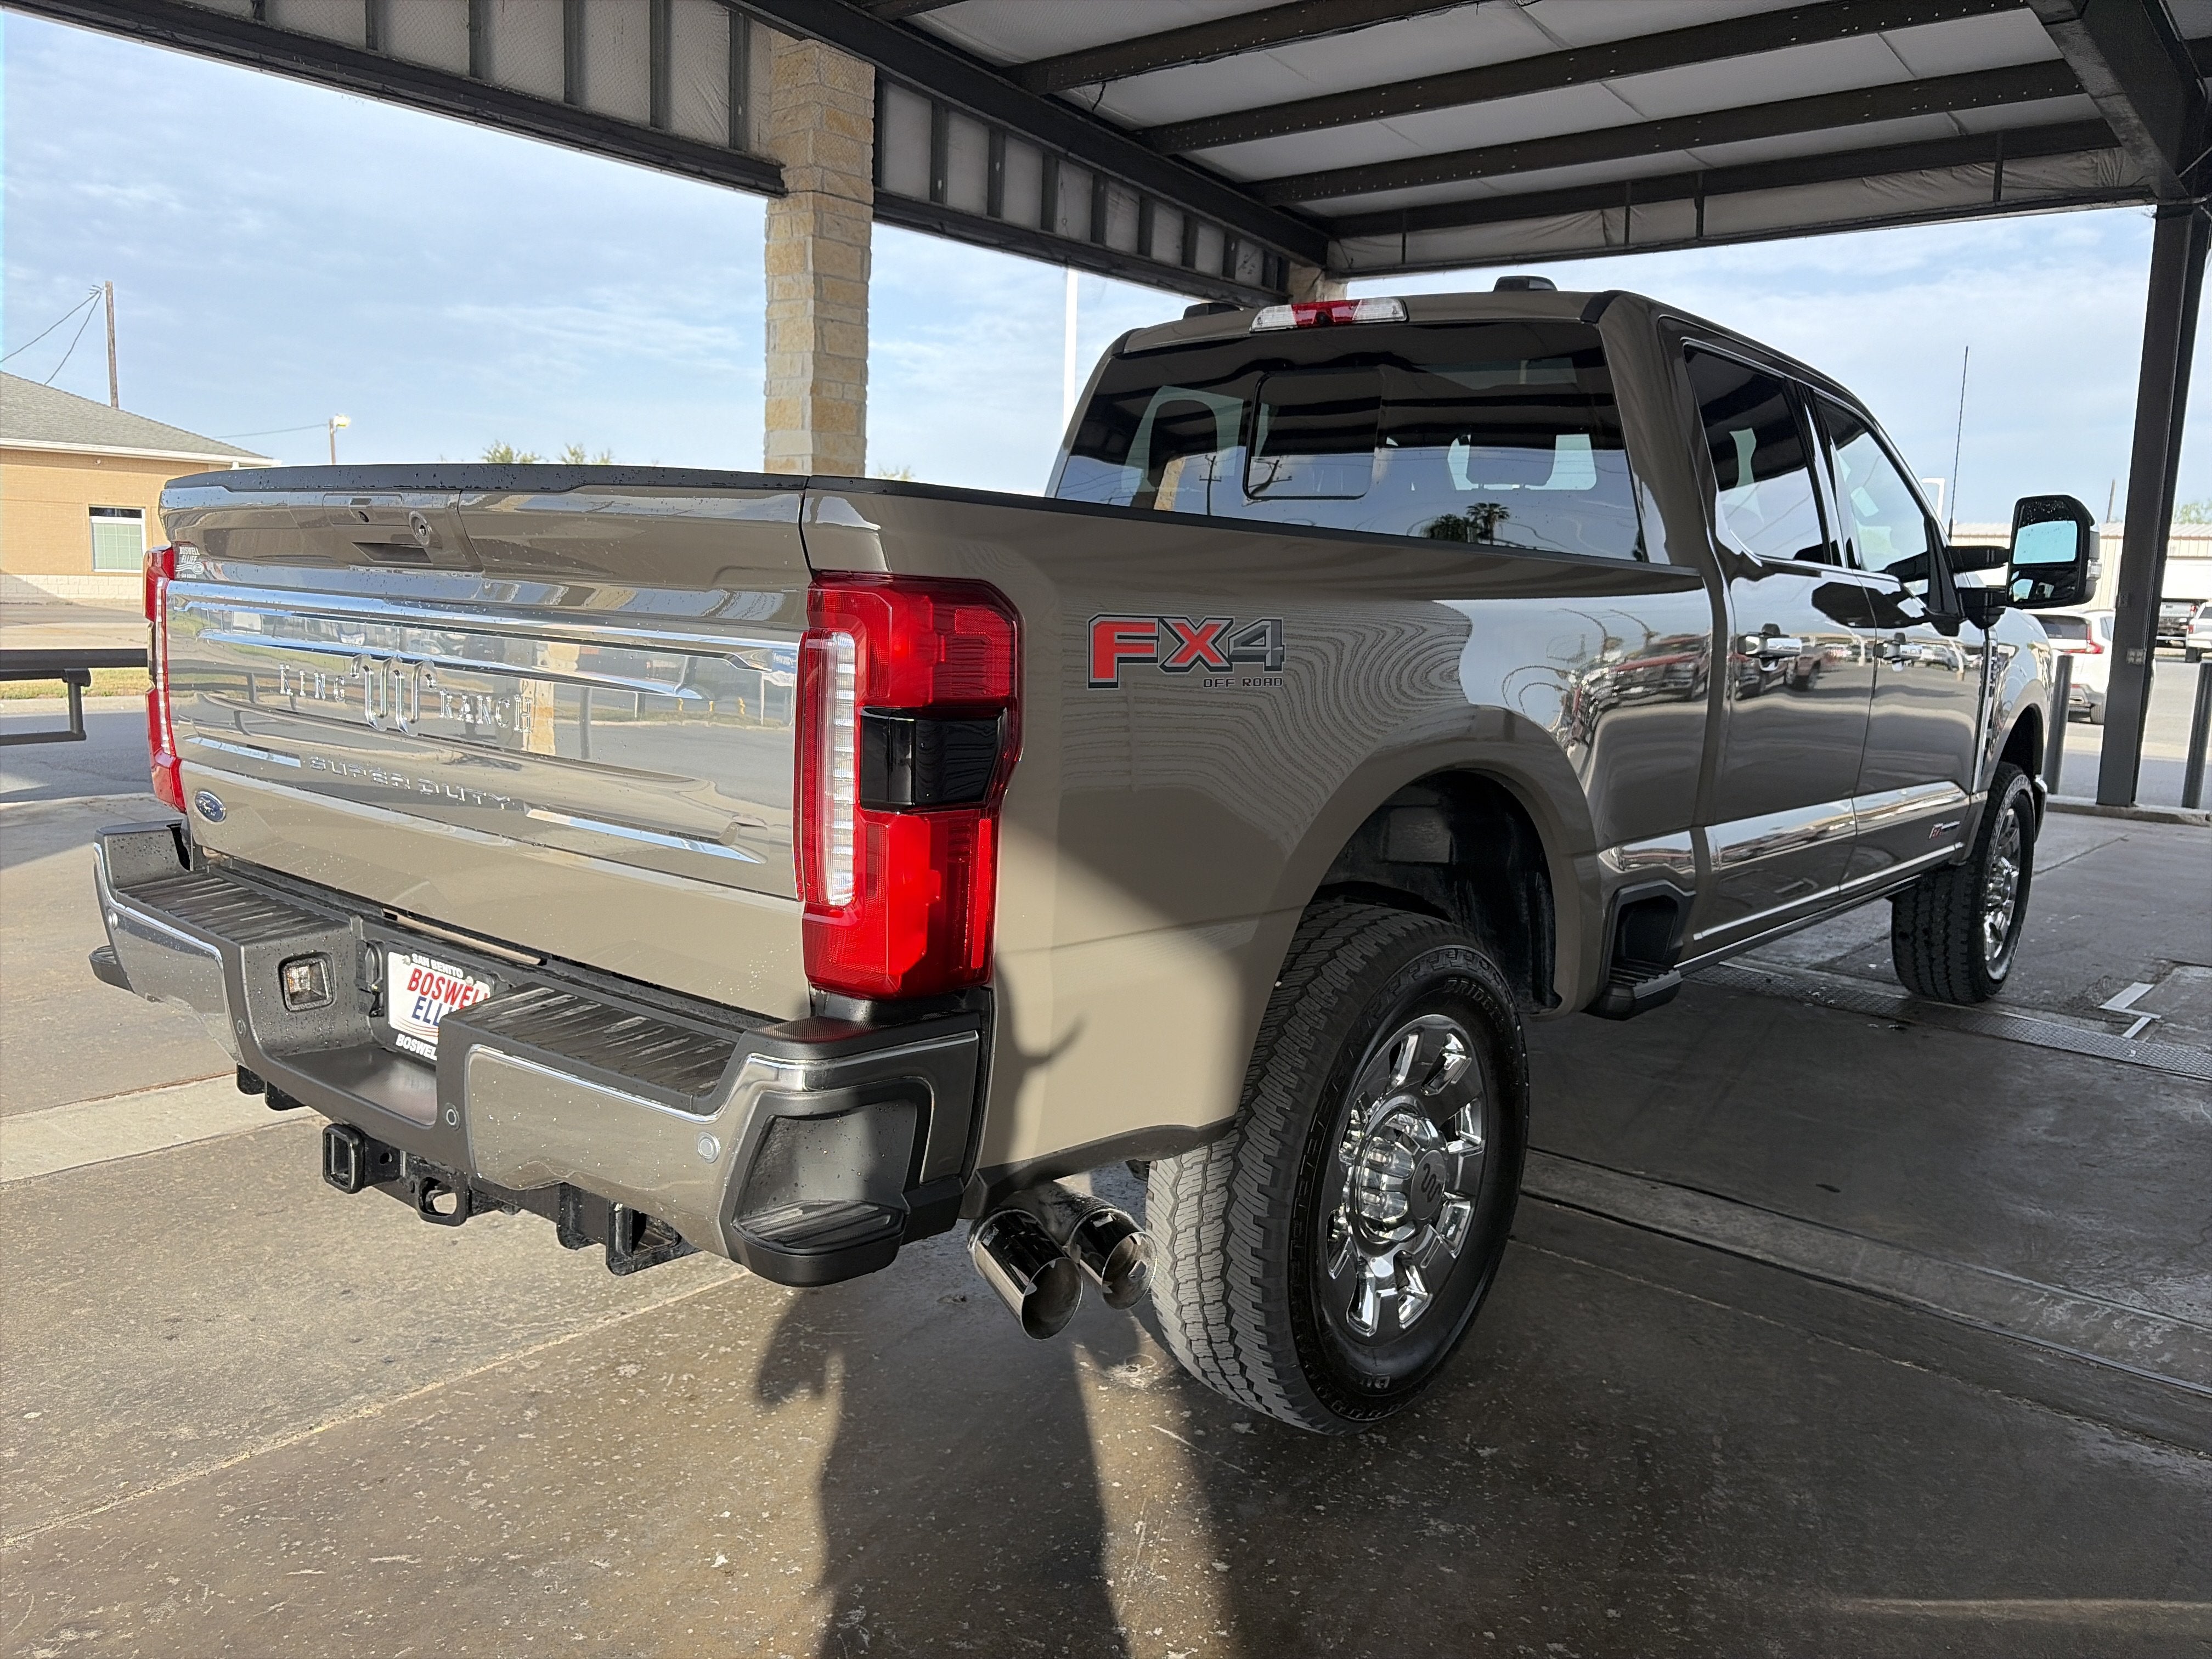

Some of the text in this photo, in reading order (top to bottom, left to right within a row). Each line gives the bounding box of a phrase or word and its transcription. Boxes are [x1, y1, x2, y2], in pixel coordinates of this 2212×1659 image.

[179, 546, 200, 555] BOSWELL
[1087, 613, 1285, 690] FX4
[1203, 676, 1283, 688] OFF ROAD
[280, 663, 533, 733] KING RANCH
[309, 756, 511, 811] SUPER DUTY
[411, 953, 464, 979] SAN BENITO
[396, 1033, 438, 1061] BOSWEL
